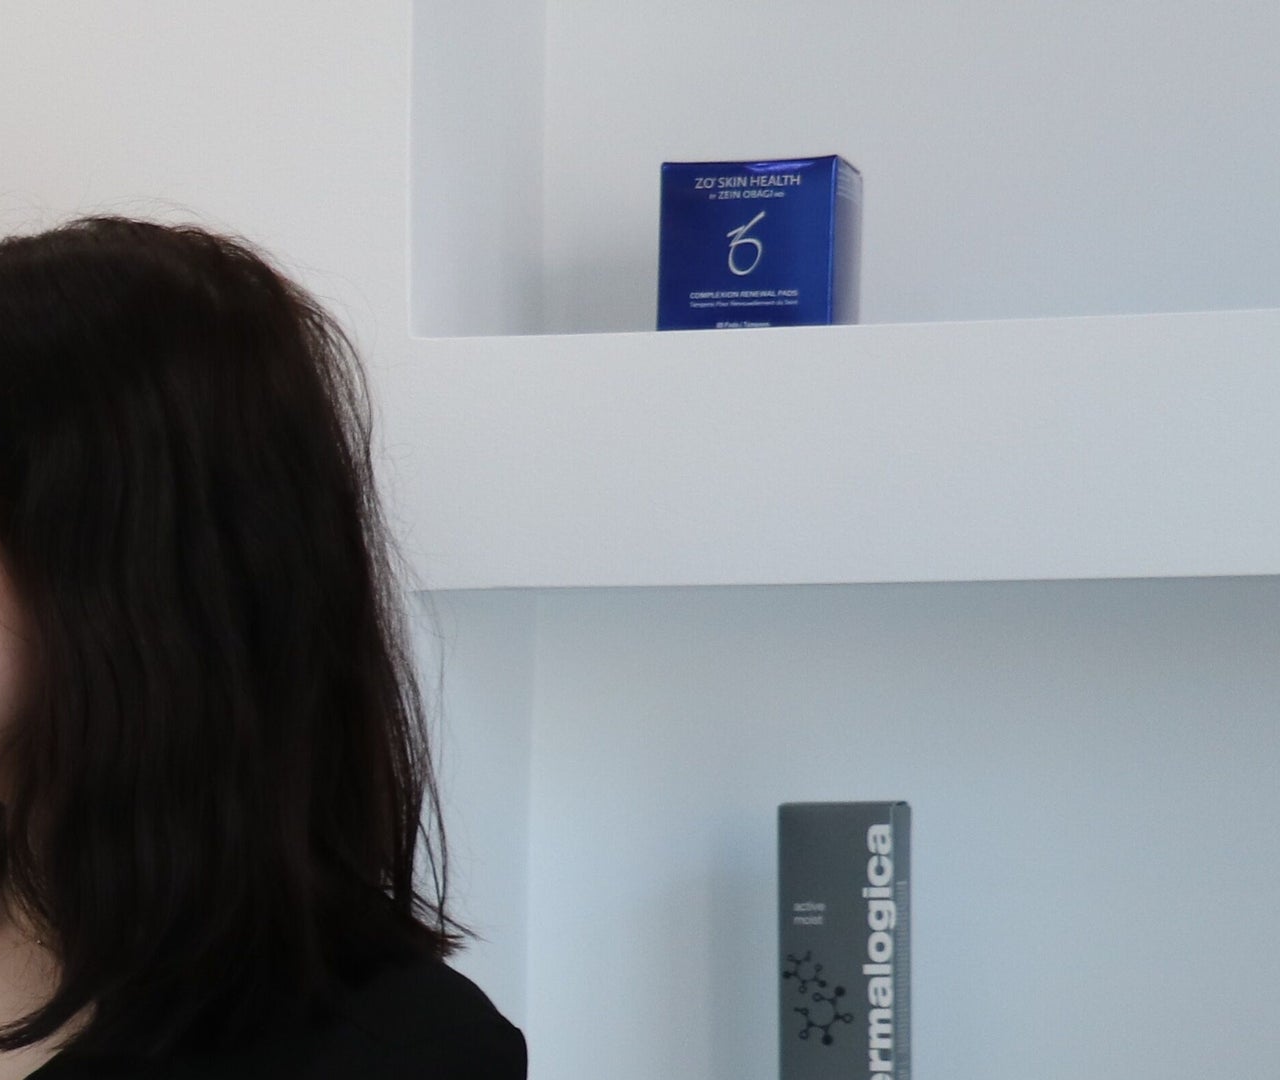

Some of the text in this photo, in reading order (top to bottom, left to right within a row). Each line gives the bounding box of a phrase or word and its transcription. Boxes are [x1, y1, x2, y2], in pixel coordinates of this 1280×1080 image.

[718, 176, 747, 188] SKIN
[750, 174, 801, 187] HEALTH
[718, 190, 740, 200] ZEIN
[742, 189, 773, 199] OBAGI
